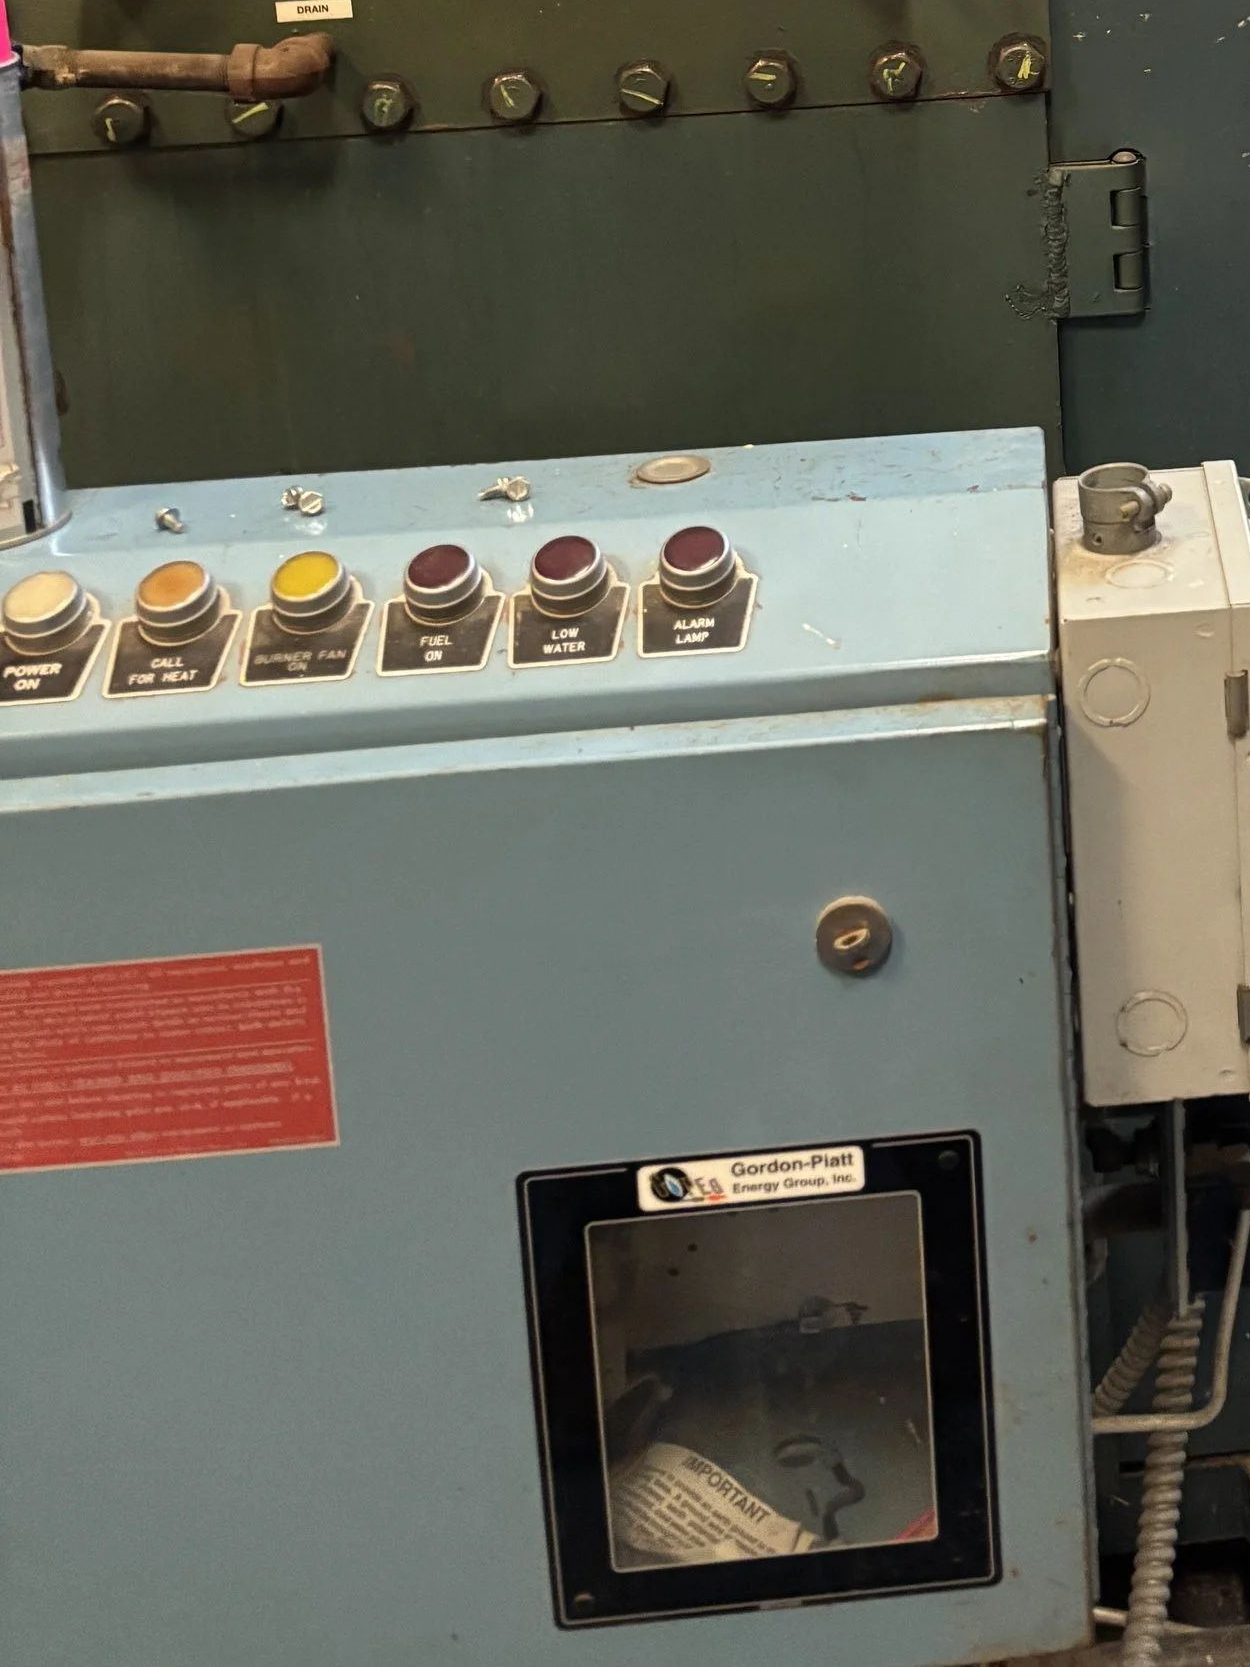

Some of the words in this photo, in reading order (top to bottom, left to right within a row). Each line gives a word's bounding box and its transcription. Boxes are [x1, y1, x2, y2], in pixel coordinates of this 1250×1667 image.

[297, 5, 329, 14] DRAIN
[674, 618, 715, 630] ALARM
[551, 628, 579, 640] LOW
[675, 632, 709, 644] LAMP
[419, 635, 452, 646] FUEL
[543, 642, 585, 654] WATER
[254, 651, 312, 665] BURNER
[318, 649, 347, 661] FAN
[424, 650, 442, 662] ON
[151, 657, 183, 669] CALL
[287, 661, 308, 672] ON
[3, 663, 63, 678] POWER
[128, 673, 155, 686] FOR
[162, 669, 199, 683] HEAT
[14, 678, 41, 691] ON
[731, 1153, 854, 1178] Gordon-Piatt
[732, 1181, 780, 1195] Energy
[783, 1176, 828, 1191] Group,
[833, 1172, 857, 1184] Inc.
[681, 1454, 771, 1524] IMPORTANT
